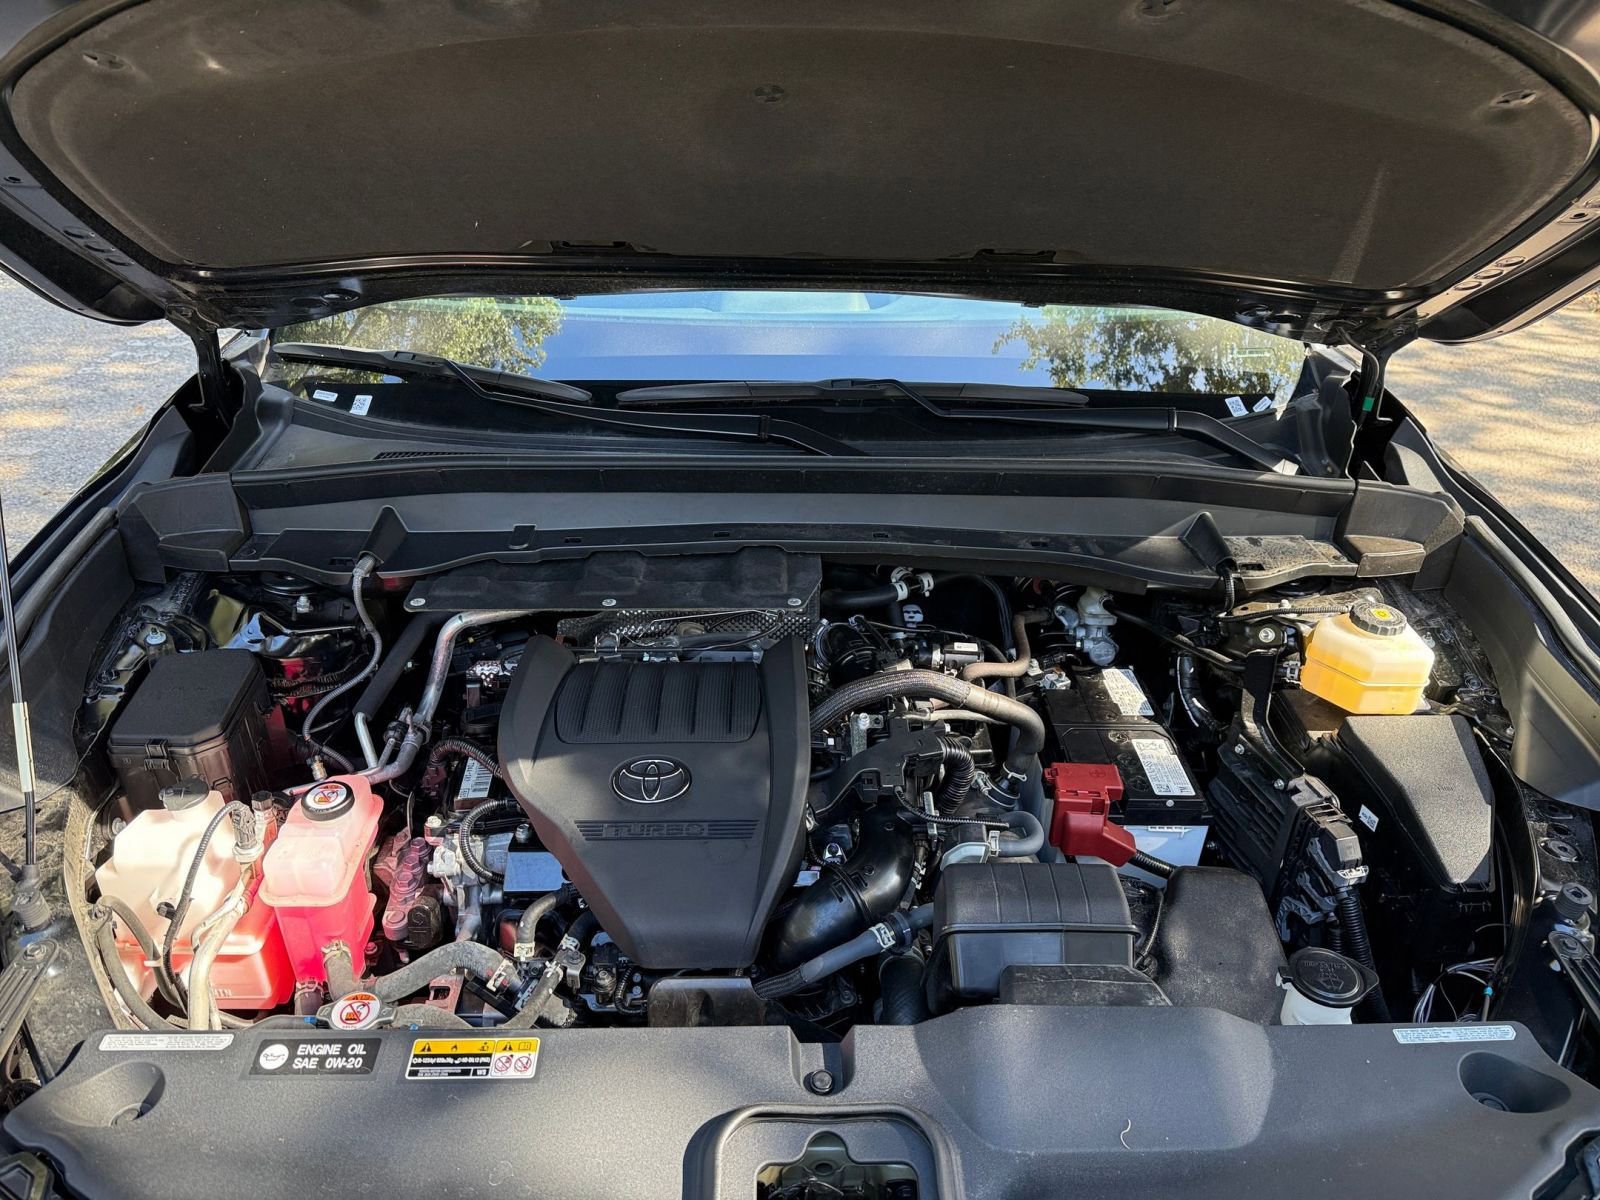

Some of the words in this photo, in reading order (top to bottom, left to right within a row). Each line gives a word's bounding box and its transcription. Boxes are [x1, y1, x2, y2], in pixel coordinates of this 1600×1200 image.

[605, 823, 706, 837] TURBO
[297, 1044, 342, 1055] ENGINE
[348, 1044, 367, 1055] OIL
[292, 1057, 319, 1069] SAE
[325, 1057, 363, 1069] 0W-20
